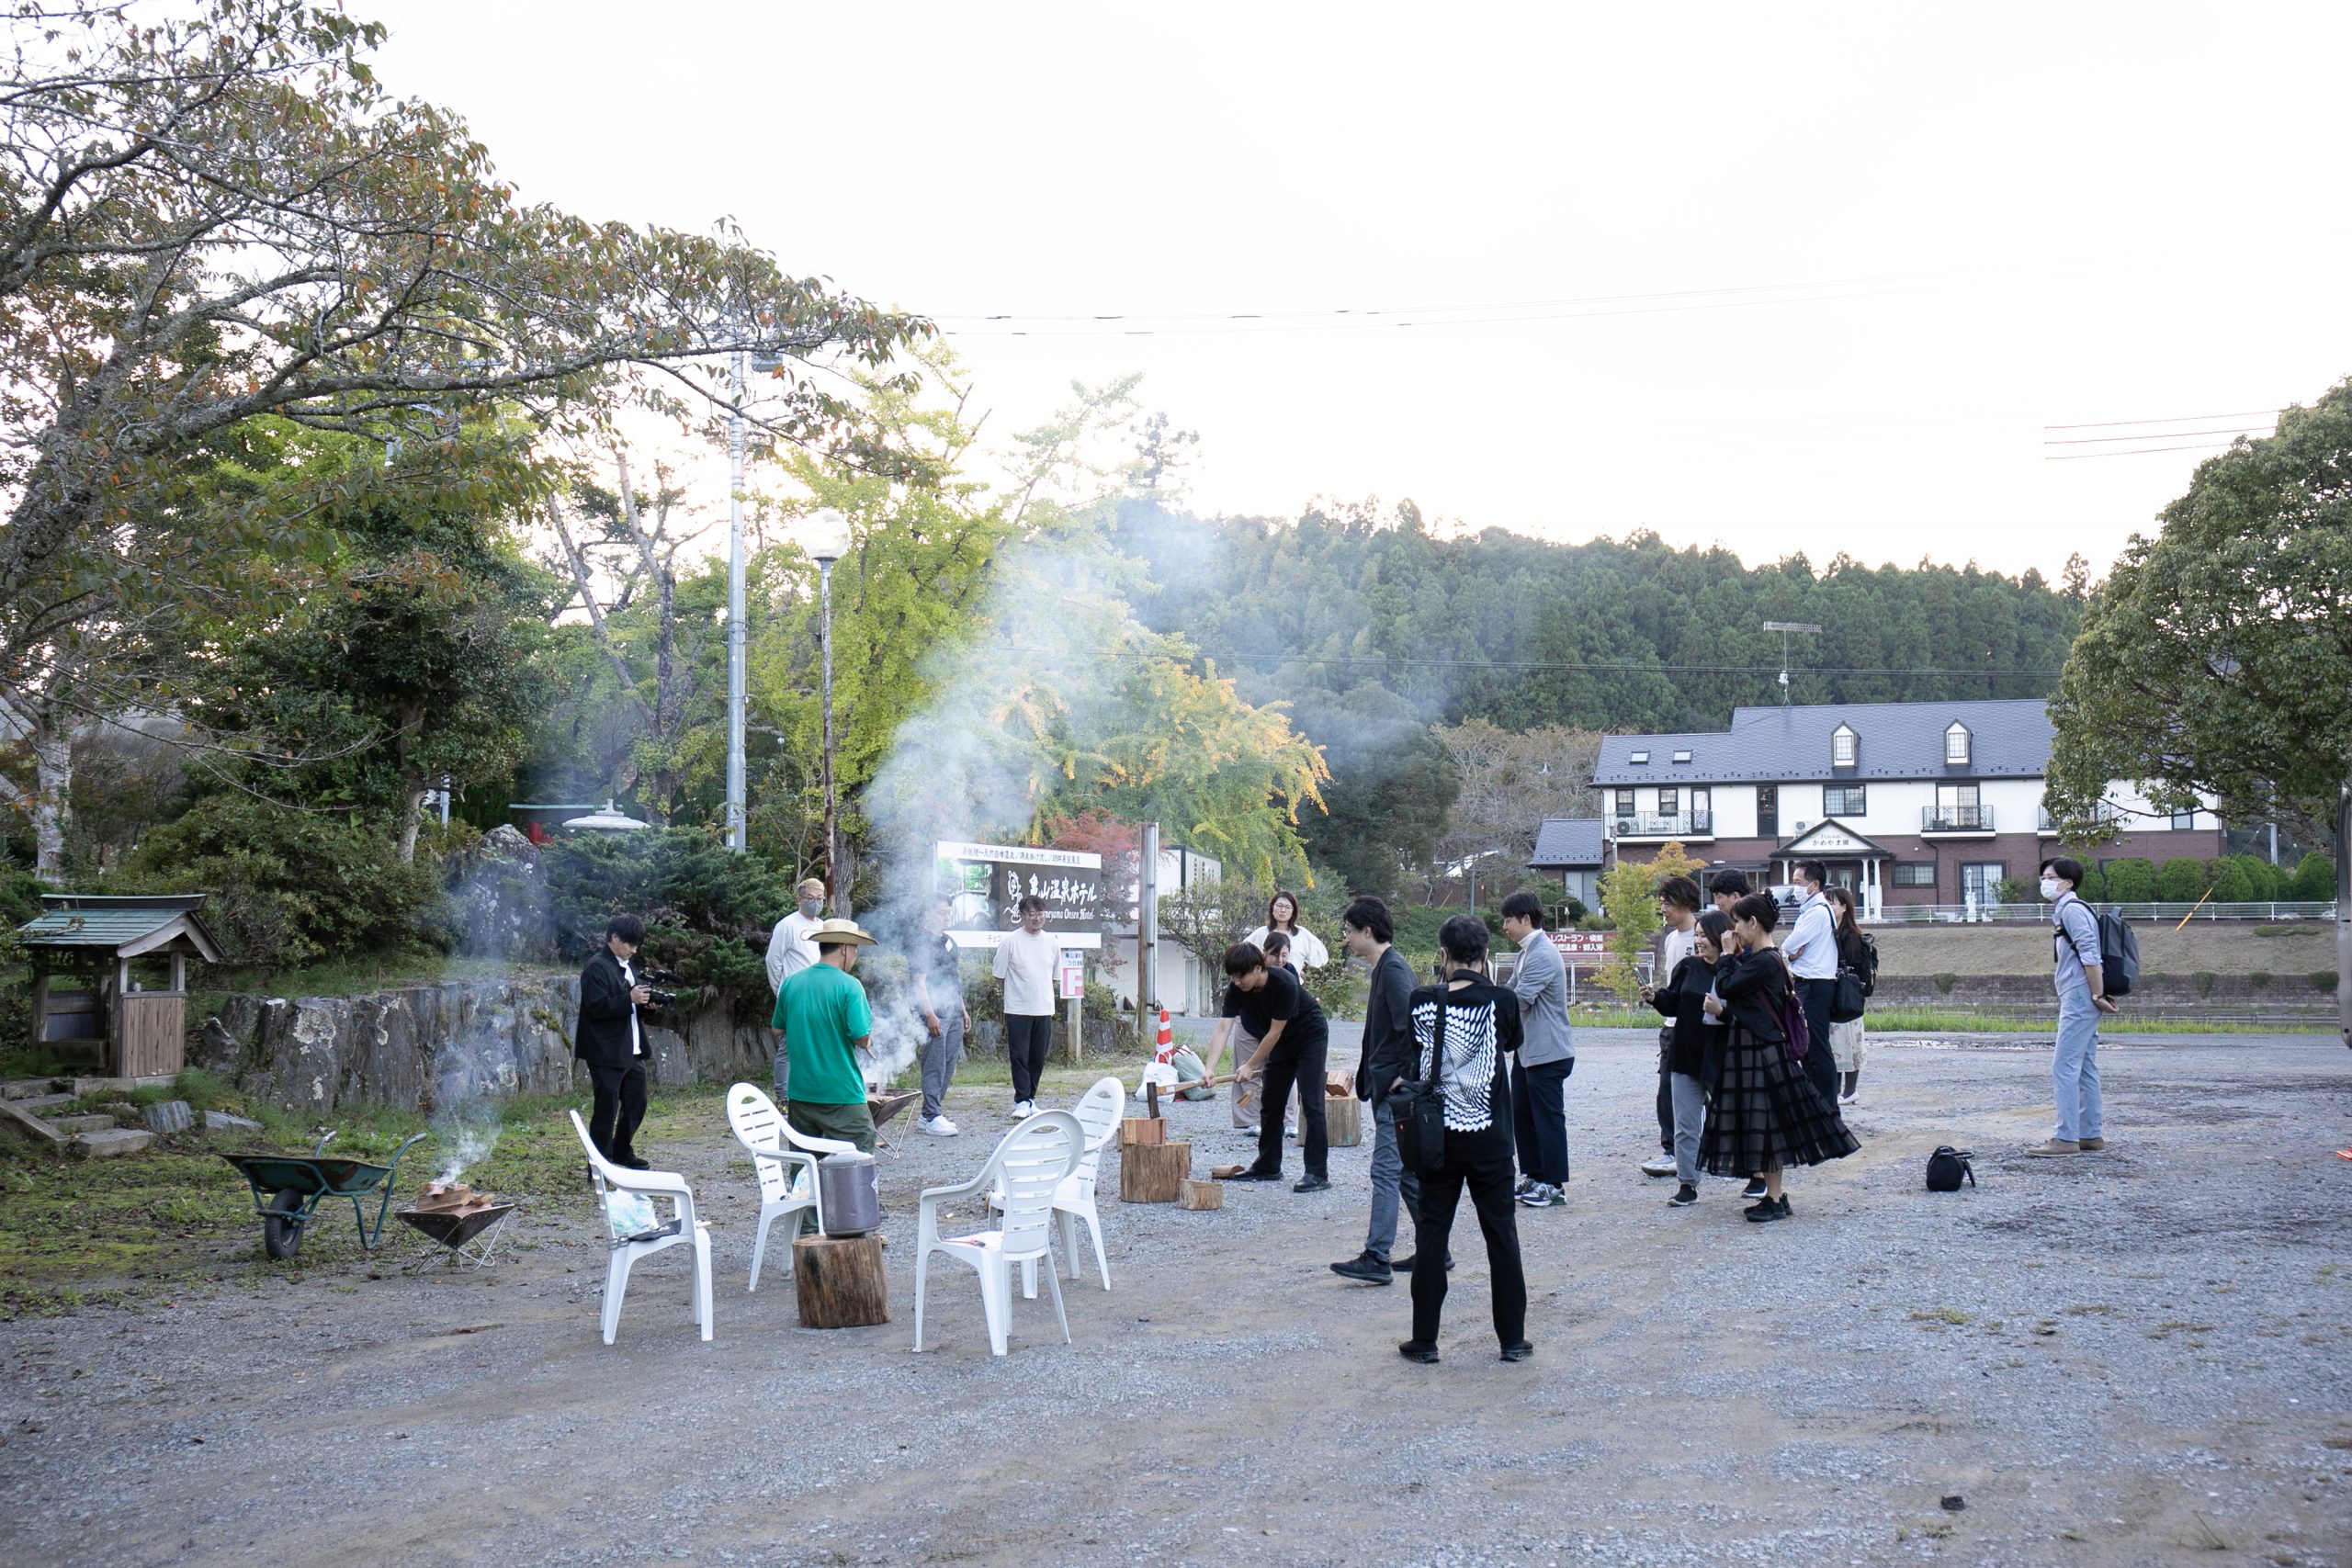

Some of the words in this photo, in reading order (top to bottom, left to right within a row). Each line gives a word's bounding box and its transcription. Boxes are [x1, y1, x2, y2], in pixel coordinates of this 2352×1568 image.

[1029, 873, 1098, 906] 亀山温泉ホテル
[1064, 908, 1080, 920] Onsen
[1554, 943, 1603, 952] 然温泉・御入浴
